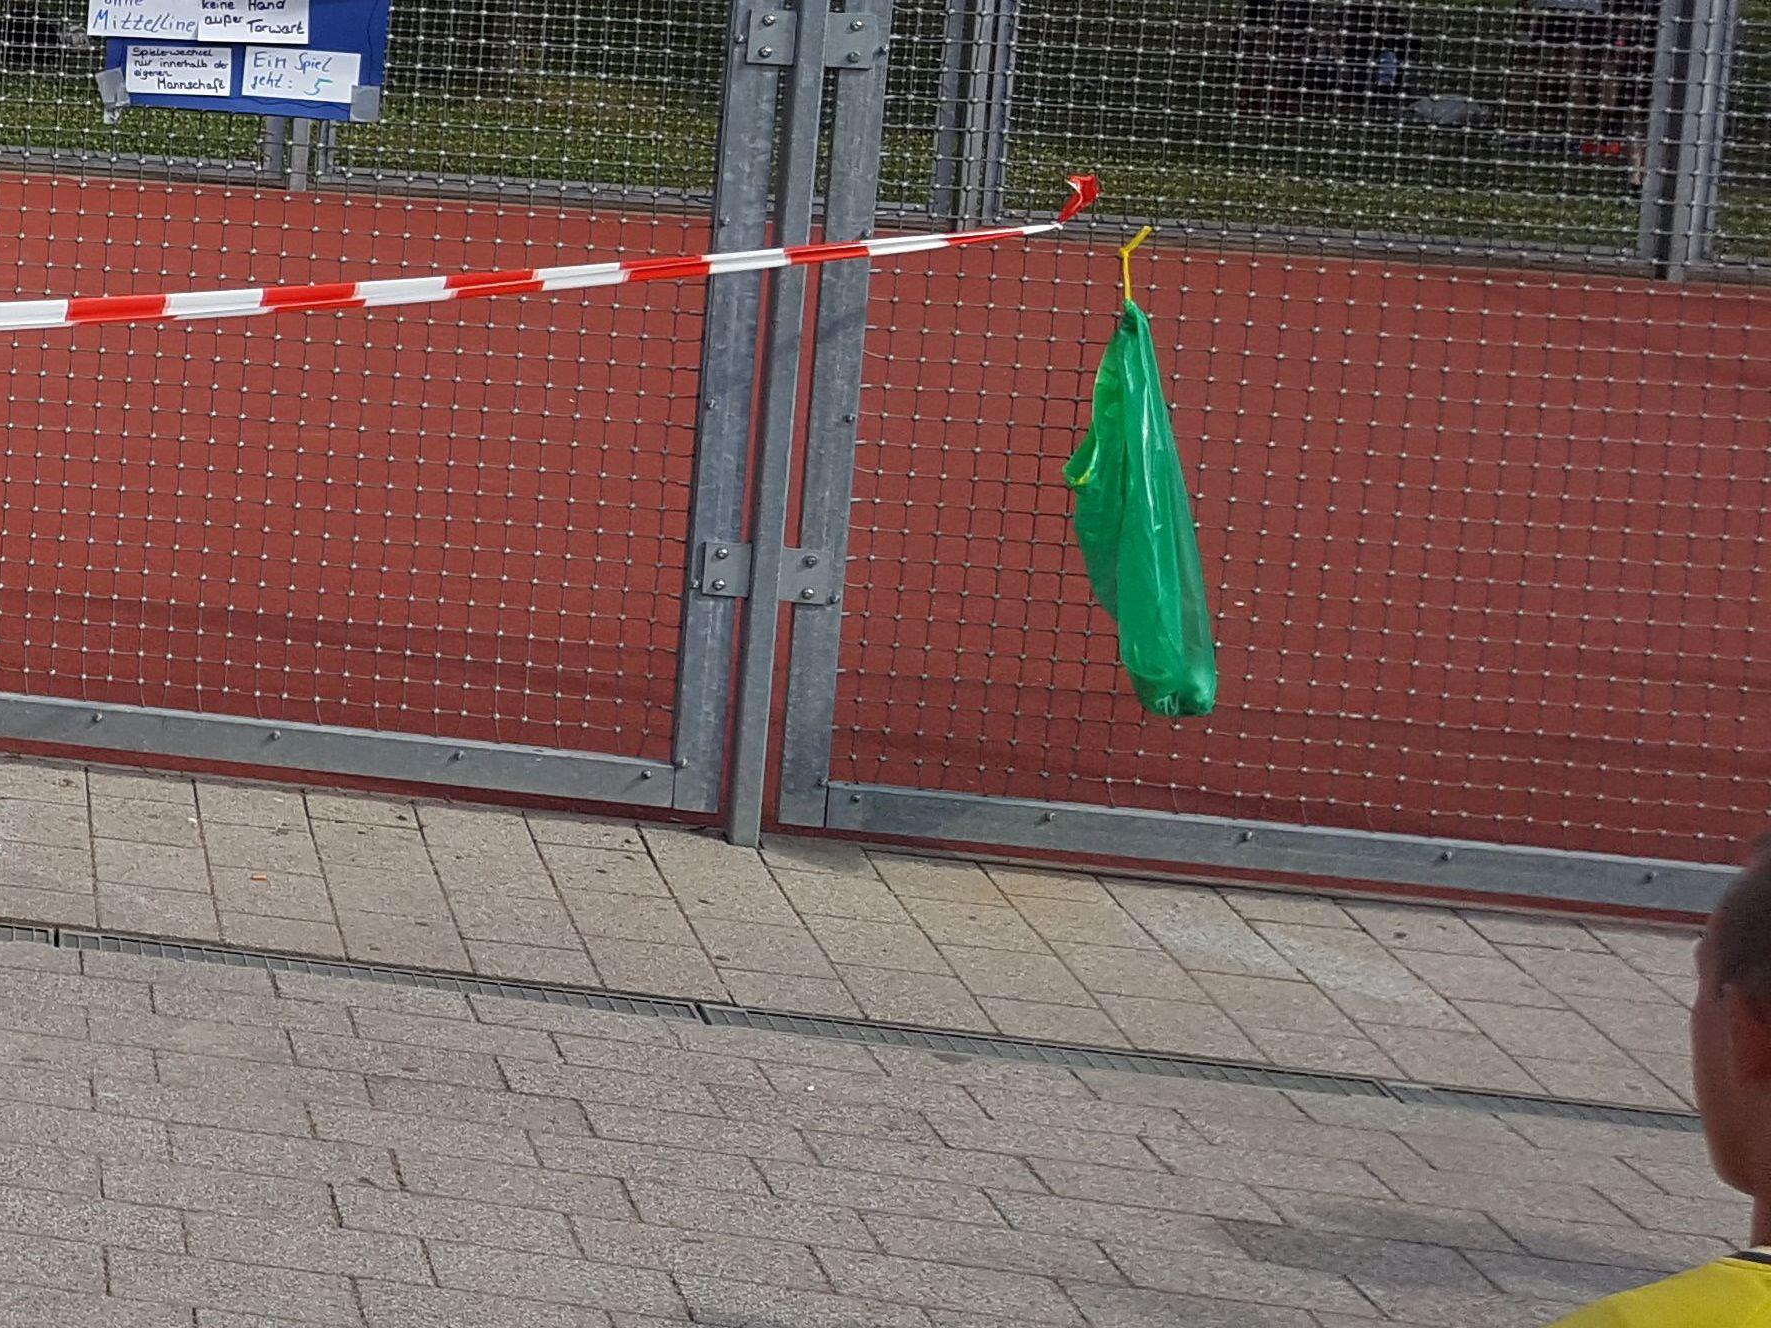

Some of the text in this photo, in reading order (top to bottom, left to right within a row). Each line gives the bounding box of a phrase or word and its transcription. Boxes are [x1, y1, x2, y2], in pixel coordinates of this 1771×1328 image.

[247, 19, 305, 34] Torwart
[254, 50, 332, 75] Ein Spiel
[157, 76, 226, 94] Mannschaft
[304, 77, 333, 96] 5
